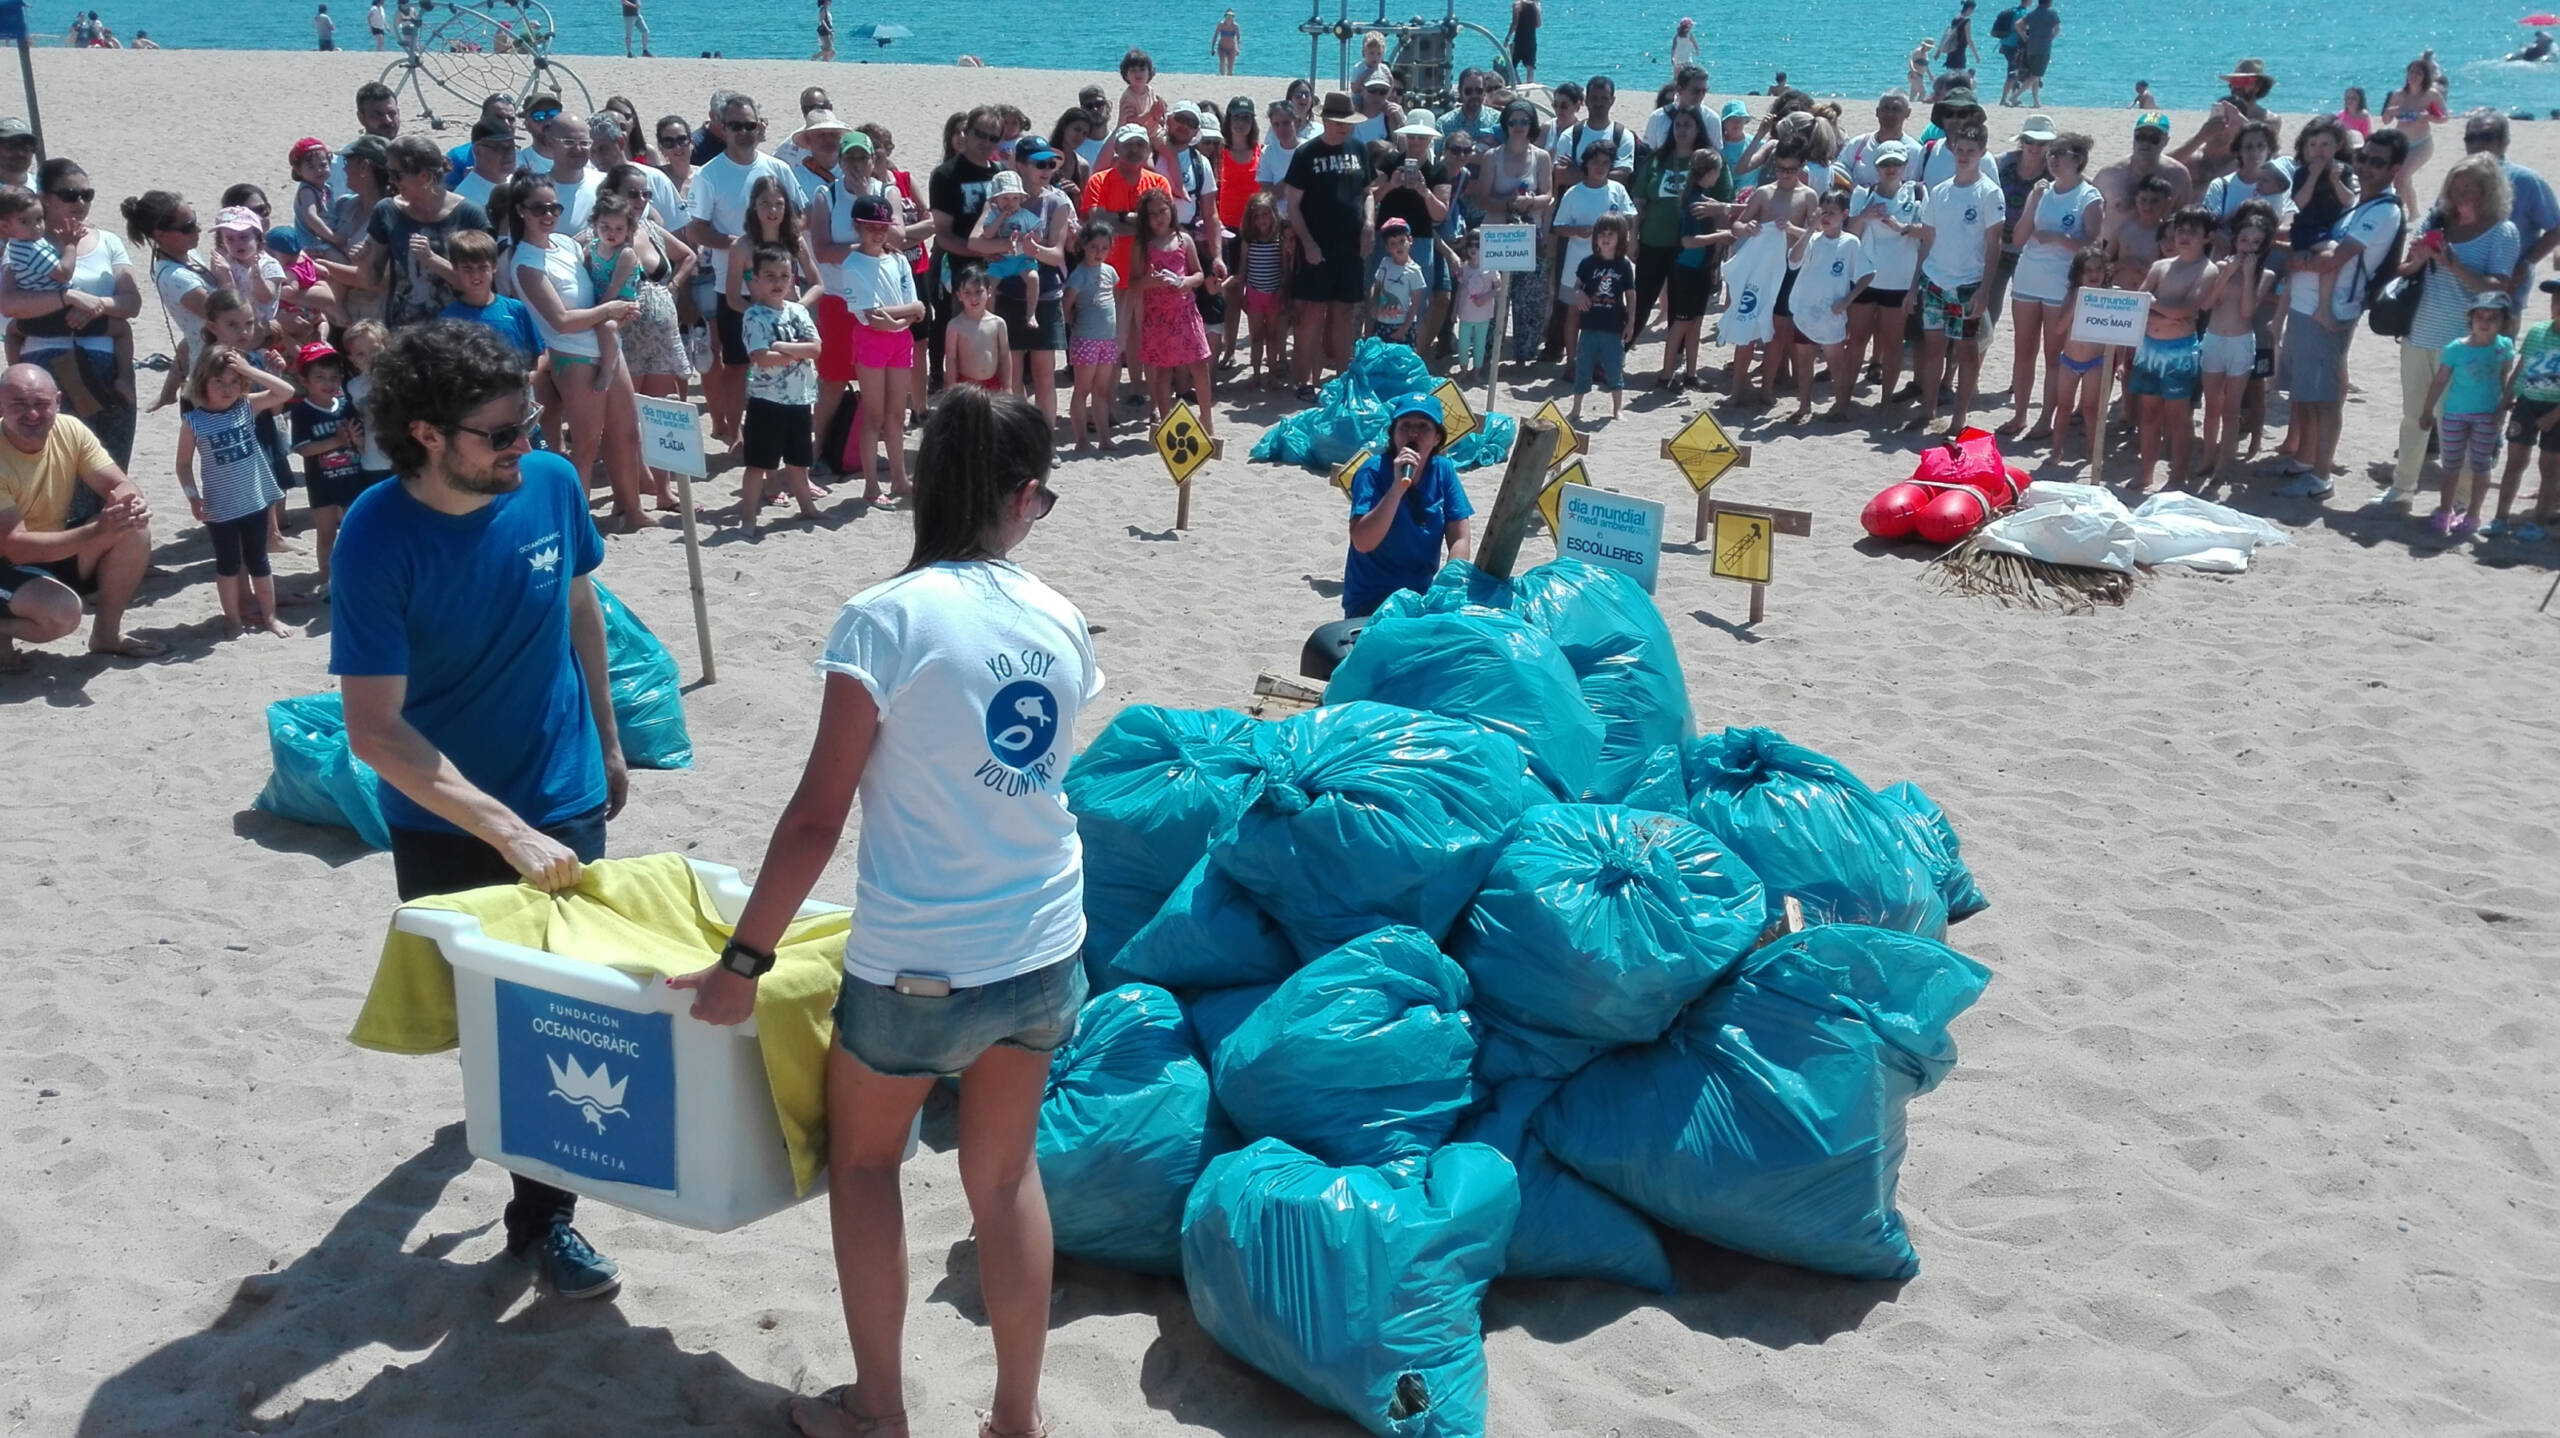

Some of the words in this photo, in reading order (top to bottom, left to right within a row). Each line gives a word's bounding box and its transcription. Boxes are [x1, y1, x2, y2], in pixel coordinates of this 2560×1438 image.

[2100, 296, 2139, 307] mundial
[2086, 316, 2109, 326] FONS
[1568, 498, 1588, 514] dia
[1591, 505, 1646, 526] mundial
[1576, 514, 1598, 526] medi
[1566, 536, 1644, 565] ESCOLLERES
[985, 652, 1012, 683] YO
[1021, 649, 1056, 678] SOY
[549, 1002, 620, 1029] FUNDACIÓN
[532, 1017, 641, 1059] OCEANOGRÀFIC
[553, 1140, 627, 1172] VALENCIA
